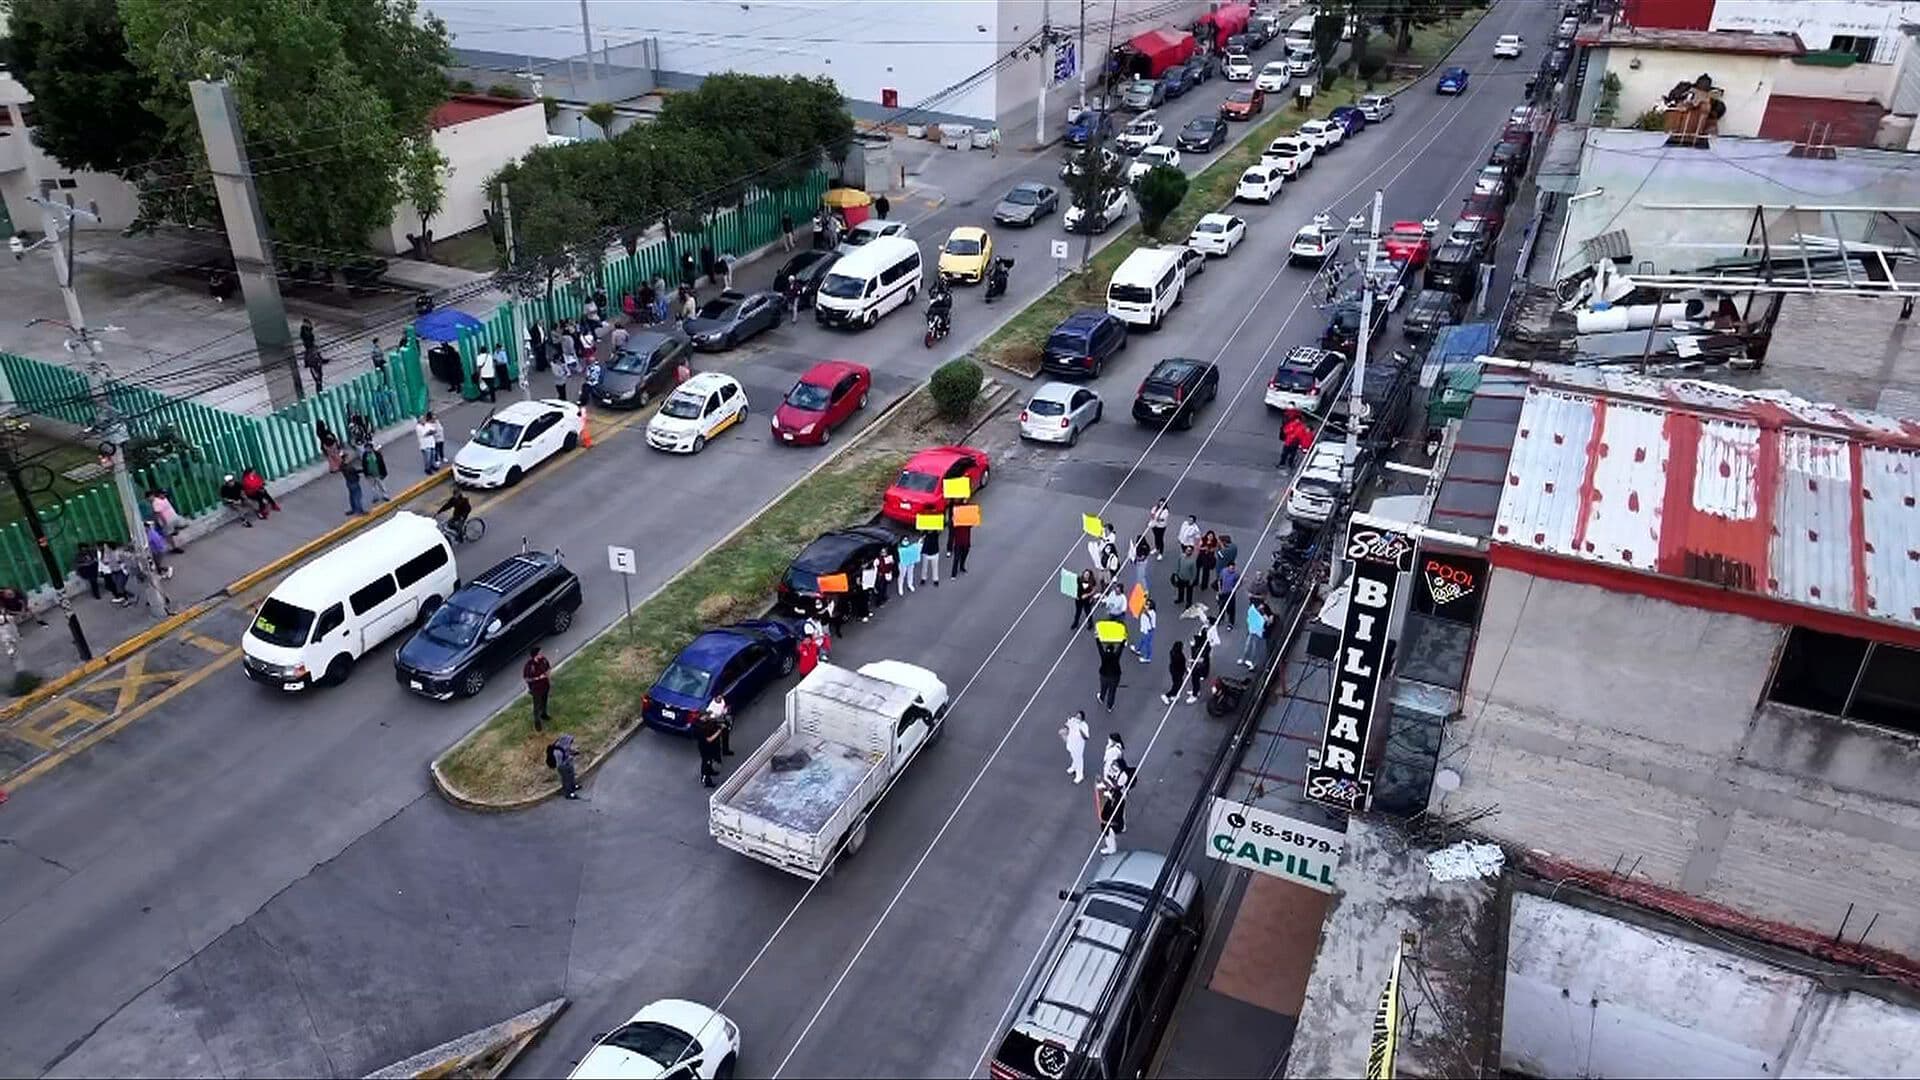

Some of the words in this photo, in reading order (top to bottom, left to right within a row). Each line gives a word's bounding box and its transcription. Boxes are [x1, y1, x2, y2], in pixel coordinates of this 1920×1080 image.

[1427, 560, 1473, 586] POOL
[1324, 577, 1388, 774] BILLAR
[1213, 834, 1334, 886] CAPILL
